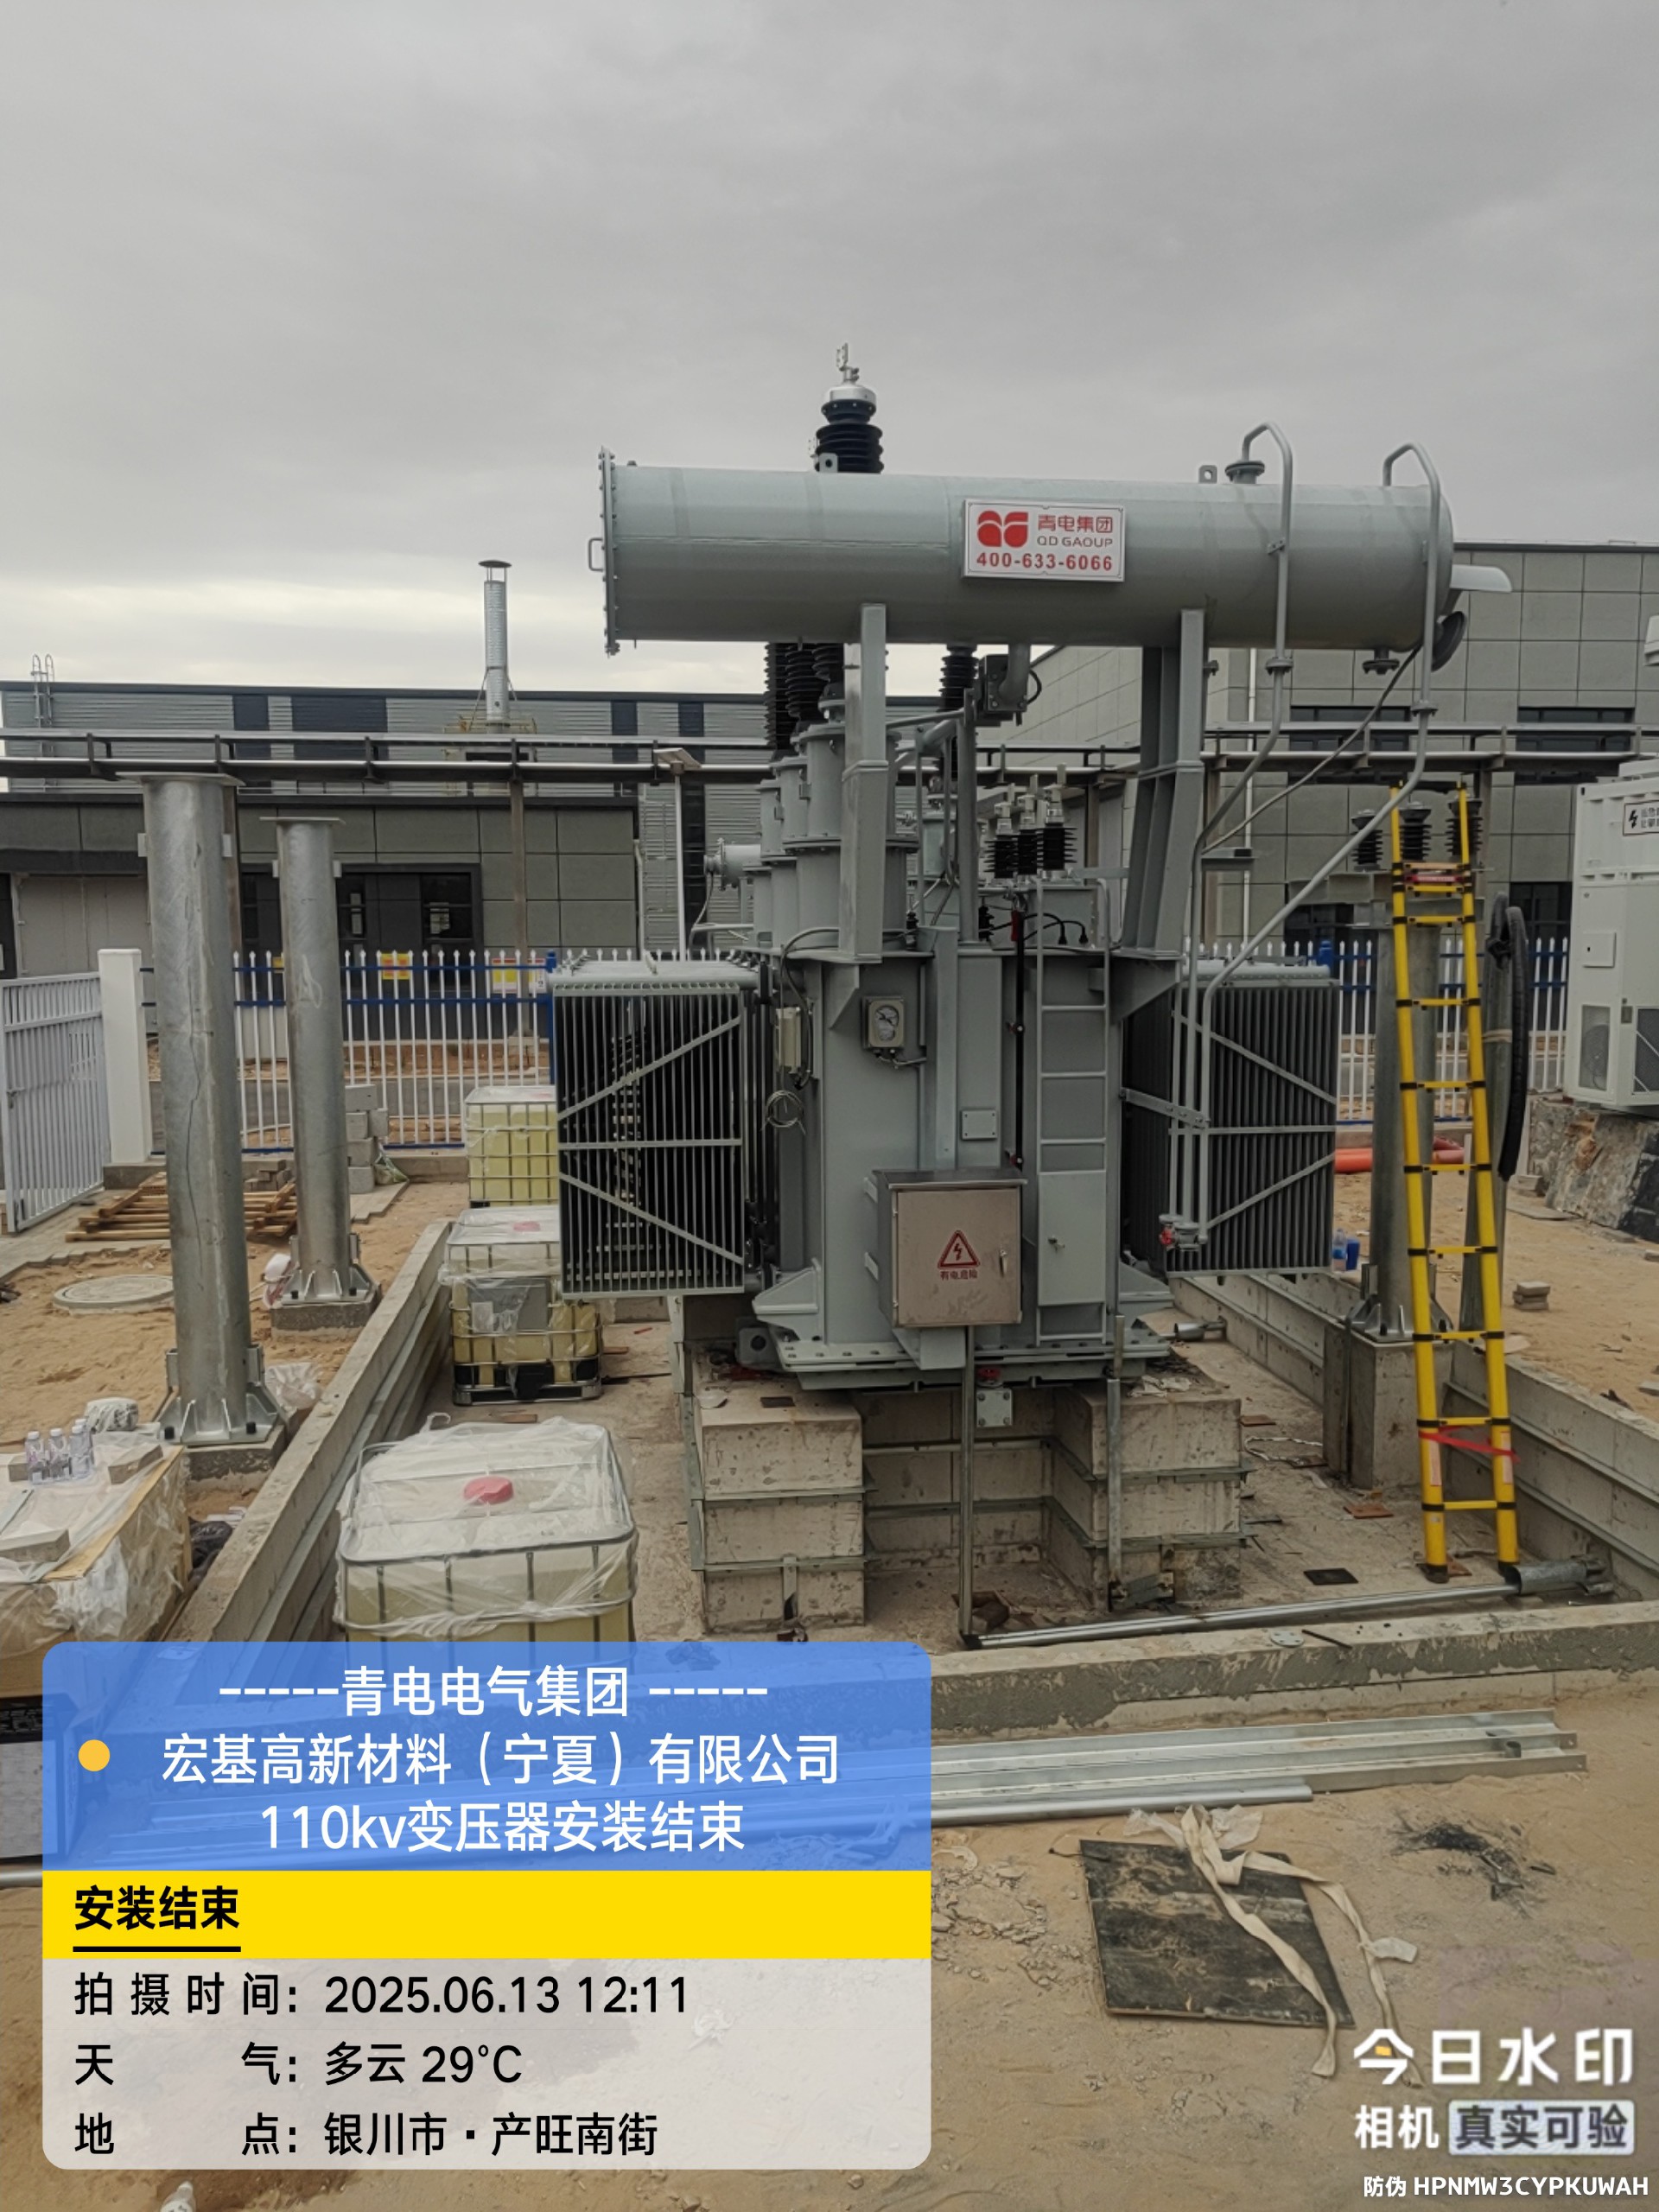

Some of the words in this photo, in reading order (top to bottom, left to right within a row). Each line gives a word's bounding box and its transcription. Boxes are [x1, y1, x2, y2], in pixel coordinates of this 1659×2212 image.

[1038, 514, 1113, 533] 青电集团
[1037, 535, 1058, 546] QD
[976, 552, 1113, 571] 400-633-6066
